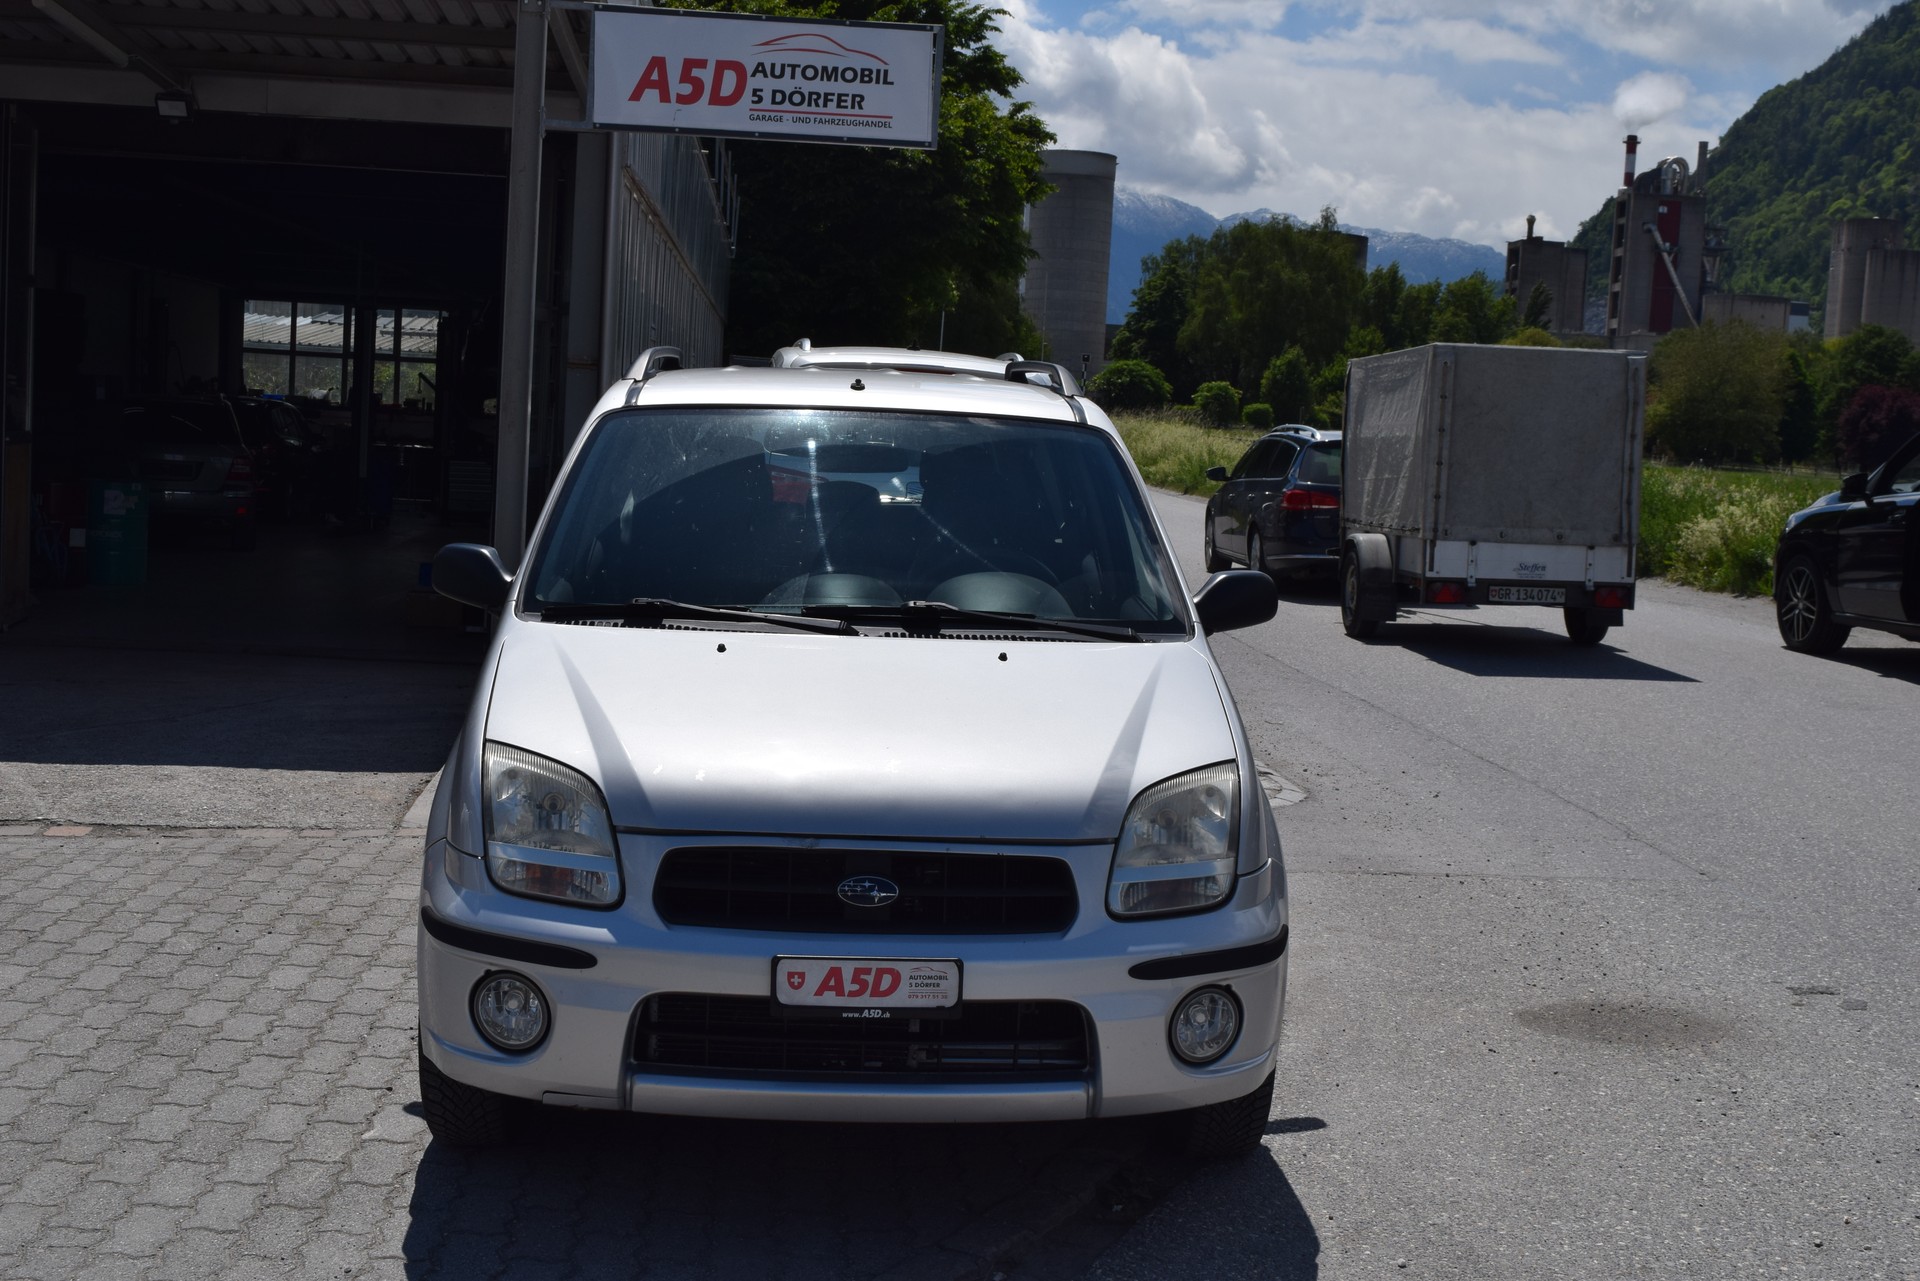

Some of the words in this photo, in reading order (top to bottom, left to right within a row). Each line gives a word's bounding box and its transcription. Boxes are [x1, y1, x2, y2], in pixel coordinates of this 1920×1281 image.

[627, 55, 748, 107] A5D
[750, 61, 895, 86] AUTOMOBIL
[751, 88, 764, 106] 5
[770, 86, 865, 111] DÖRFER
[749, 113, 784, 123] GARAGE
[791, 116, 812, 125] UND
[813, 117, 893, 129] FAHRZEUGHANDEL
[1518, 562, 1547, 573] Steffen
[813, 966, 902, 998] A5D
[842, 1009, 891, 1018] www.A5D.ch
